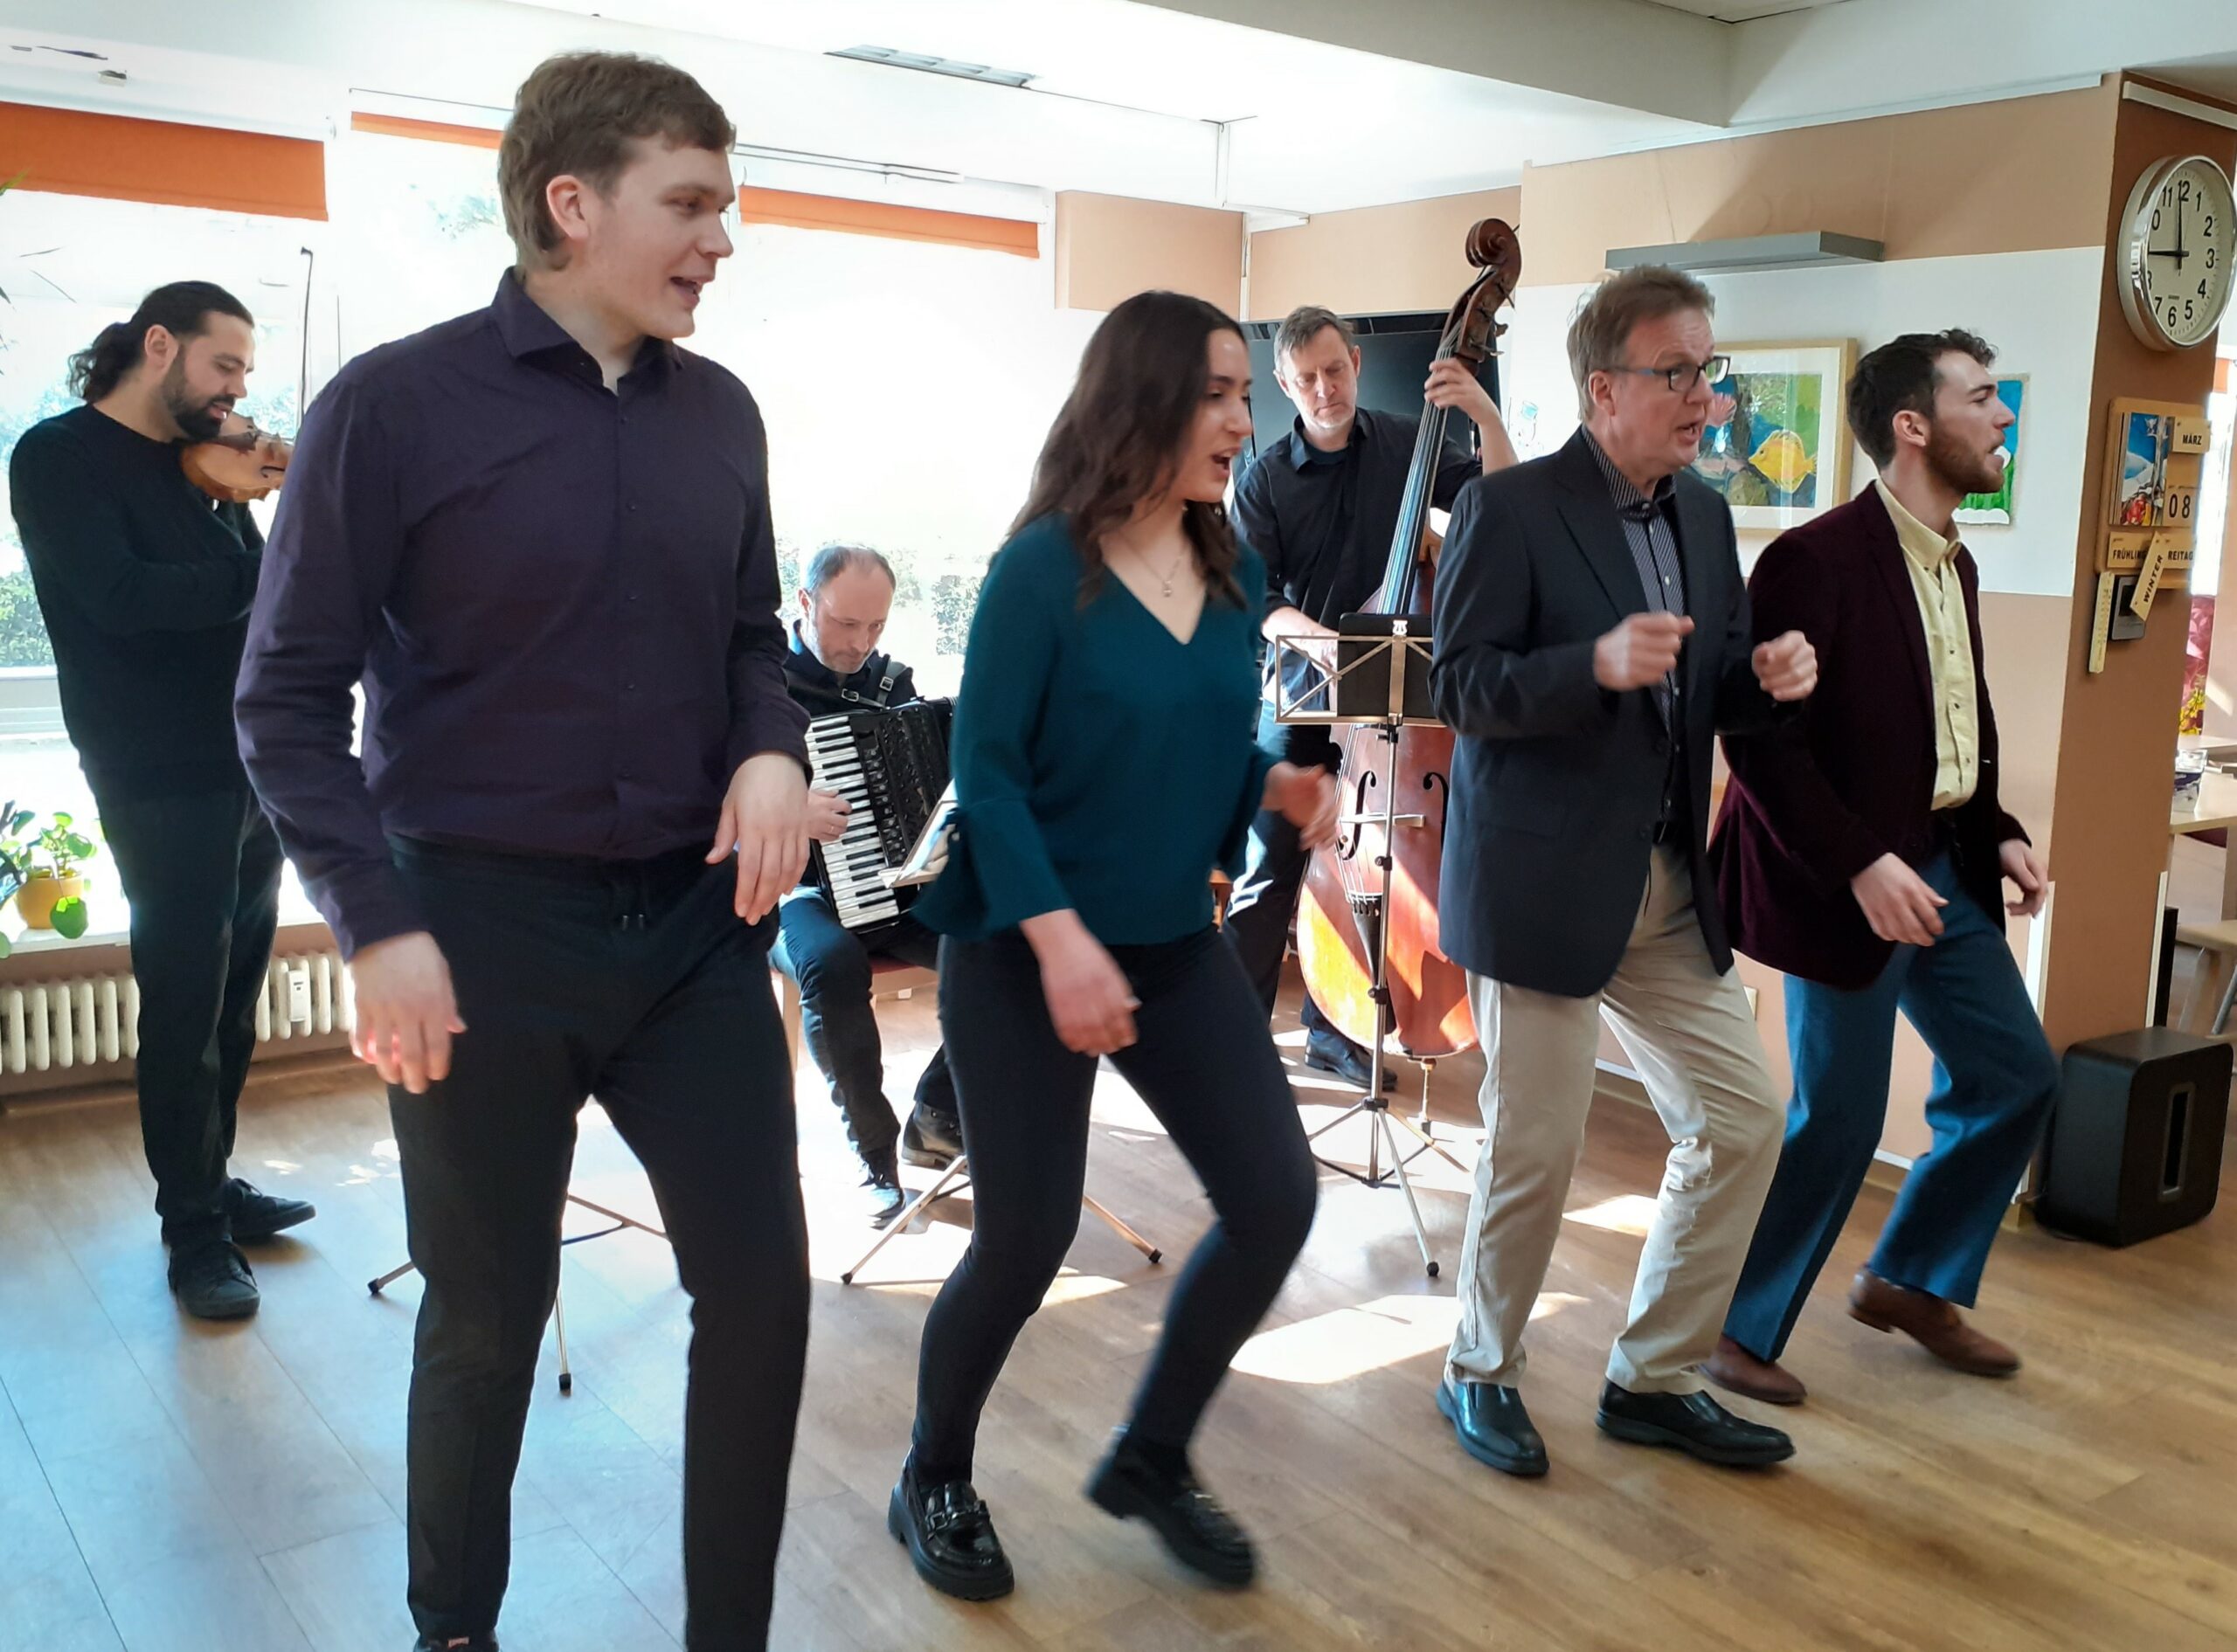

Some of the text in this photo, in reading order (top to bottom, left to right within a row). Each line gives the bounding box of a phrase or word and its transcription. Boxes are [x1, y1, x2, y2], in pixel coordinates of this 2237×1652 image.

[2163, 185, 2172, 207] 11
[2178, 180, 2190, 202] 12
[2197, 191, 2201, 211] 1
[2151, 209, 2160, 231] 0
[2203, 216, 2213, 237] 2
[2206, 248, 2214, 269] 3
[2198, 279, 2206, 299] 4
[2155, 296, 2163, 315] 7
[2185, 300, 2193, 320] 5
[2168, 306, 2177, 328] 6
[2182, 433, 2202, 446] MÄRZ
[2169, 494, 2191, 518] 08
[2113, 548, 2145, 560] FRÜHLIN
[2167, 550, 2194, 560] REITAG
[2144, 555, 2164, 603] WINTER
